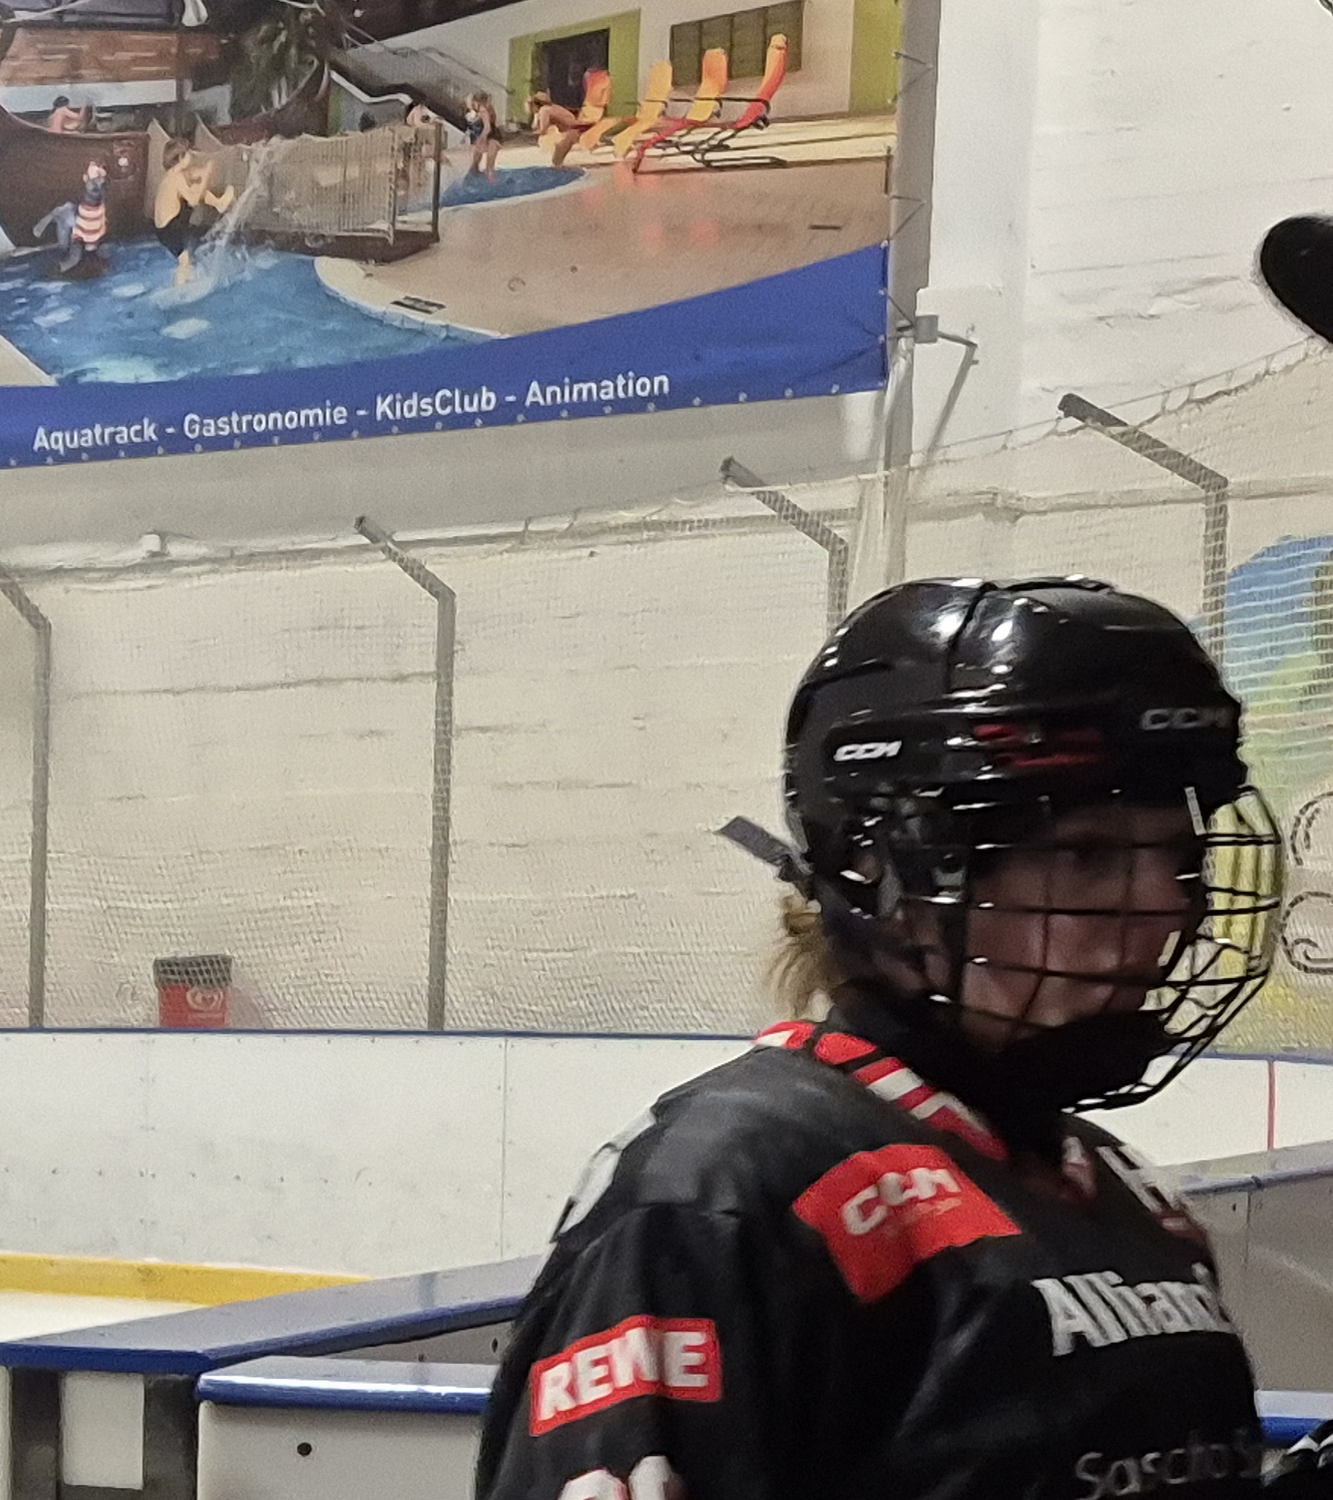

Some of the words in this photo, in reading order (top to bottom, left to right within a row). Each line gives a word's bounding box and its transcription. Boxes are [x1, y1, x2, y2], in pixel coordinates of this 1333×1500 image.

[33, 416, 159, 456] Aquatrack
[183, 399, 349, 439] Gastronomie
[375, 385, 497, 422] KidsClub
[524, 370, 670, 408] Animation
[537, 1326, 710, 1421] REWE
